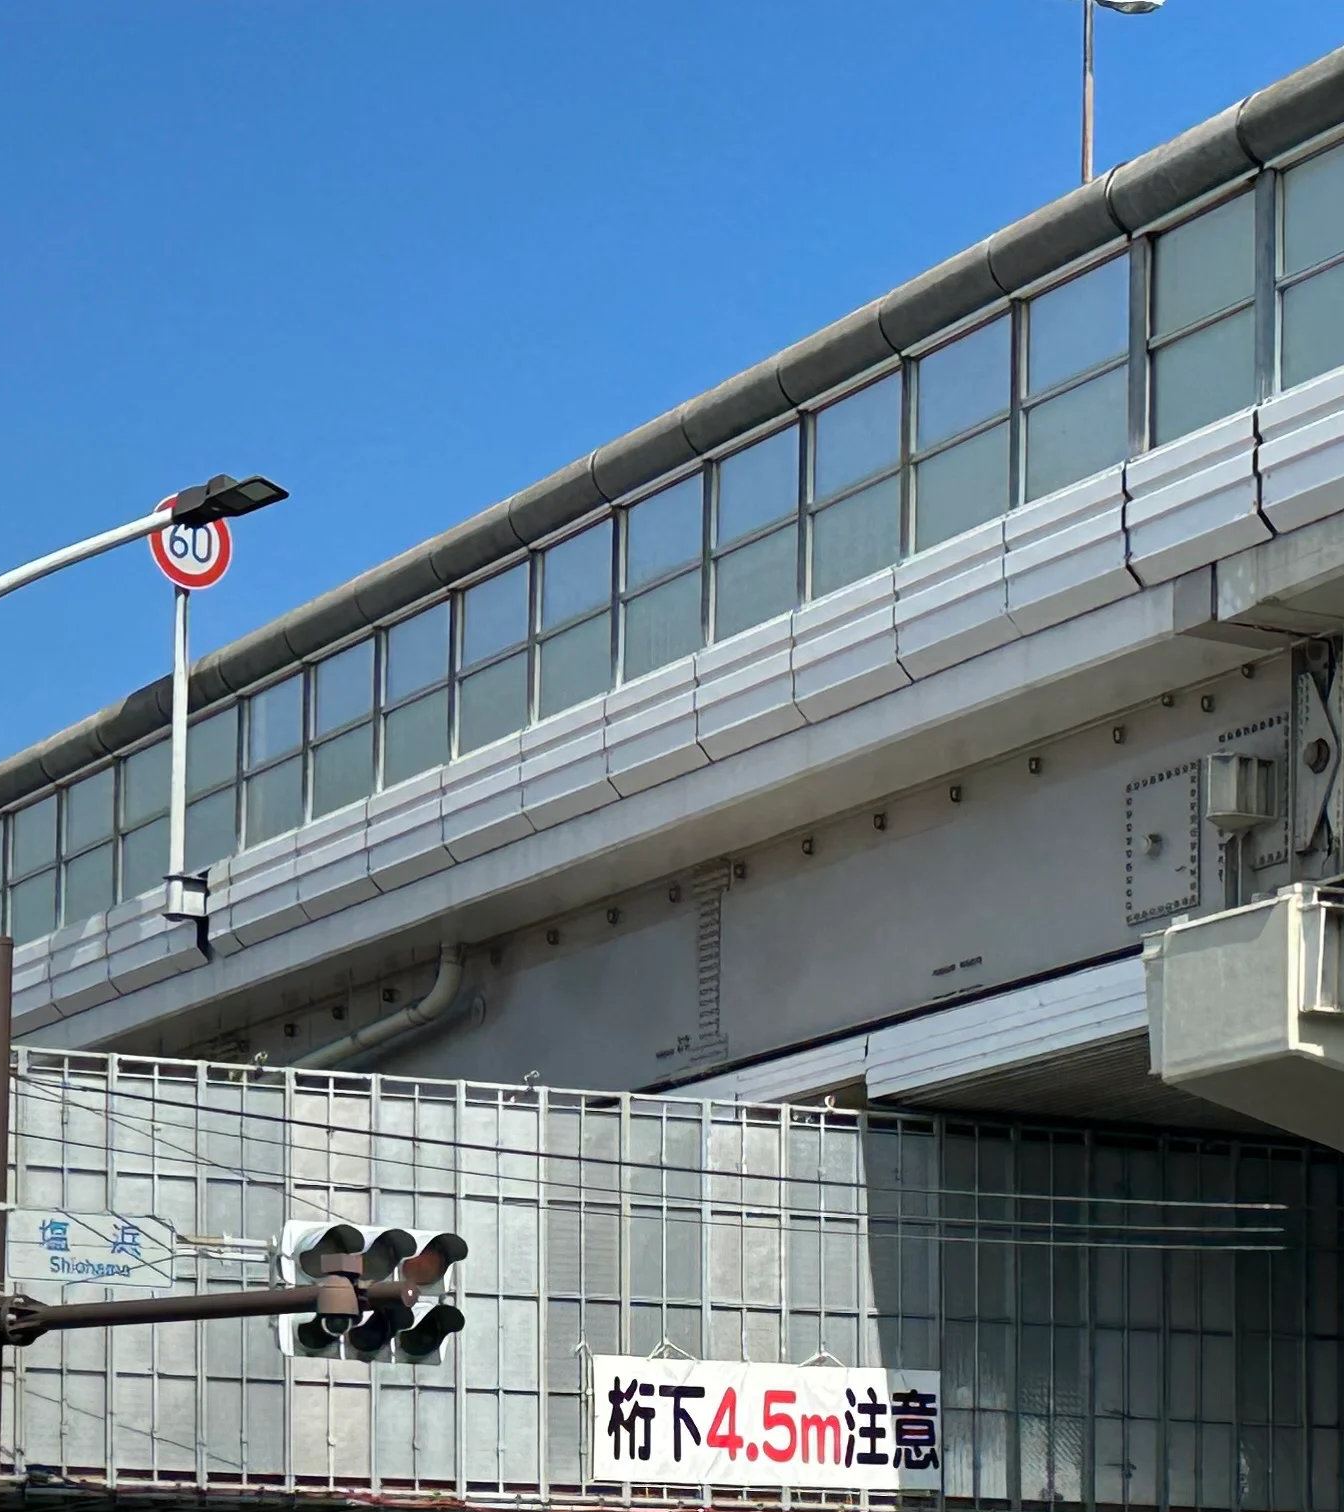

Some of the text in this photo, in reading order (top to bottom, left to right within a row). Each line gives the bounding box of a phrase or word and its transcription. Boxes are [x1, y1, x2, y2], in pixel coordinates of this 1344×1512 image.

[169, 522, 212, 563] 60
[607, 1376, 940, 1470] 桁下4.5m注意
